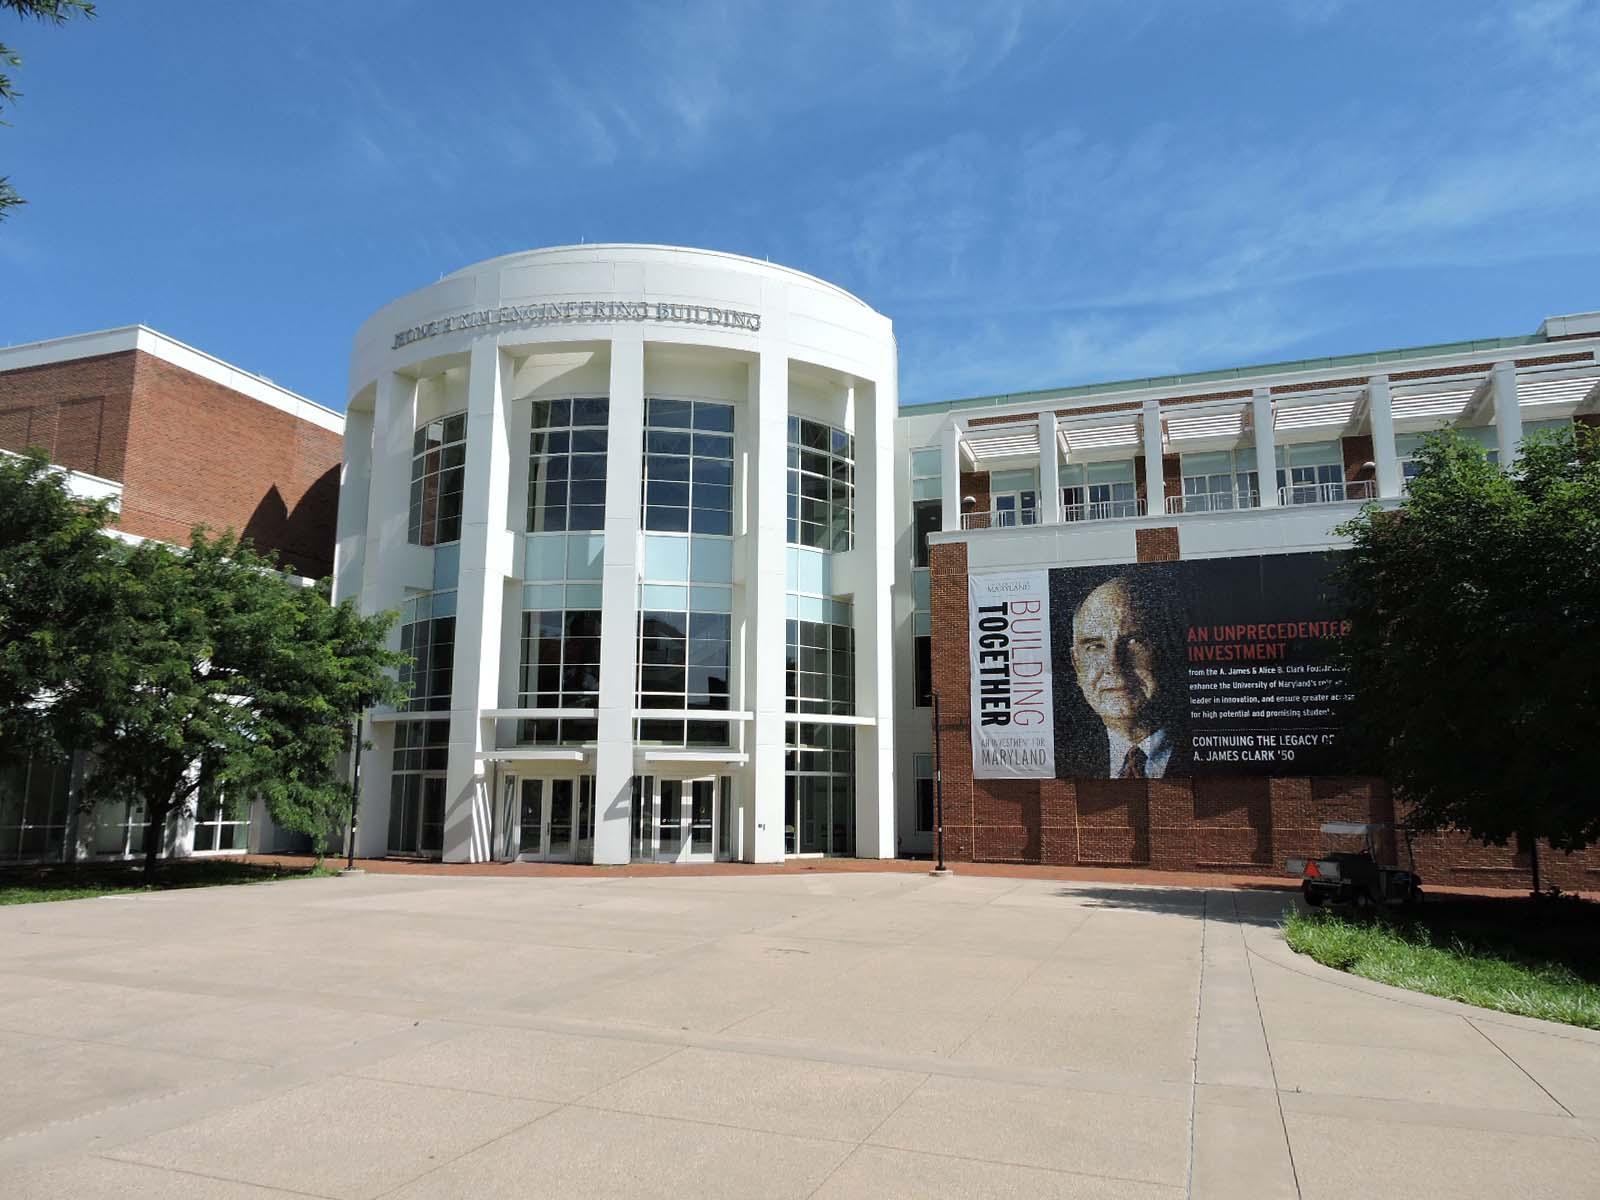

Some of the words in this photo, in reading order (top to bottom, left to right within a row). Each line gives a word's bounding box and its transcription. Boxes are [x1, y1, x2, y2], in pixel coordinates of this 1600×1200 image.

[498, 302, 648, 322] ENGINEERING
[655, 303, 760, 331] BUILDING
[985, 583, 1031, 592] MARYLAND
[1187, 626, 1209, 642] AN
[1188, 643, 1288, 662] INVESTMENT
[978, 602, 1010, 727] TOGETHER
[1010, 600, 1044, 726] BUILDING
[1228, 667, 1250, 675] James
[1258, 666, 1276, 674] Alice
[1286, 665, 1304, 673] Clark
[1232, 681, 1267, 690] University
[1269, 680, 1277, 688] of
[1278, 679, 1317, 689] Maryland's
[1189, 696, 1211, 704] leader
[1213, 696, 1220, 704] in
[1221, 695, 1260, 704] innovation,
[1261, 695, 1274, 703] and
[1276, 695, 1301, 703] ensure
[1302, 694, 1328, 703] greater
[1202, 711, 1218, 719] high
[1219, 710, 1250, 719] potential
[1265, 709, 1301, 719] promising
[1192, 736, 1254, 747] CONTINUING
[1256, 735, 1276, 746] THE
[1279, 735, 1318, 746] LEGACY
[982, 749, 1046, 765] MARYLAND
[1193, 751, 1203, 761] A.
[1206, 750, 1239, 761] JAMES
[1241, 750, 1275, 761] CLARK
[1278, 750, 1295, 760] '50
